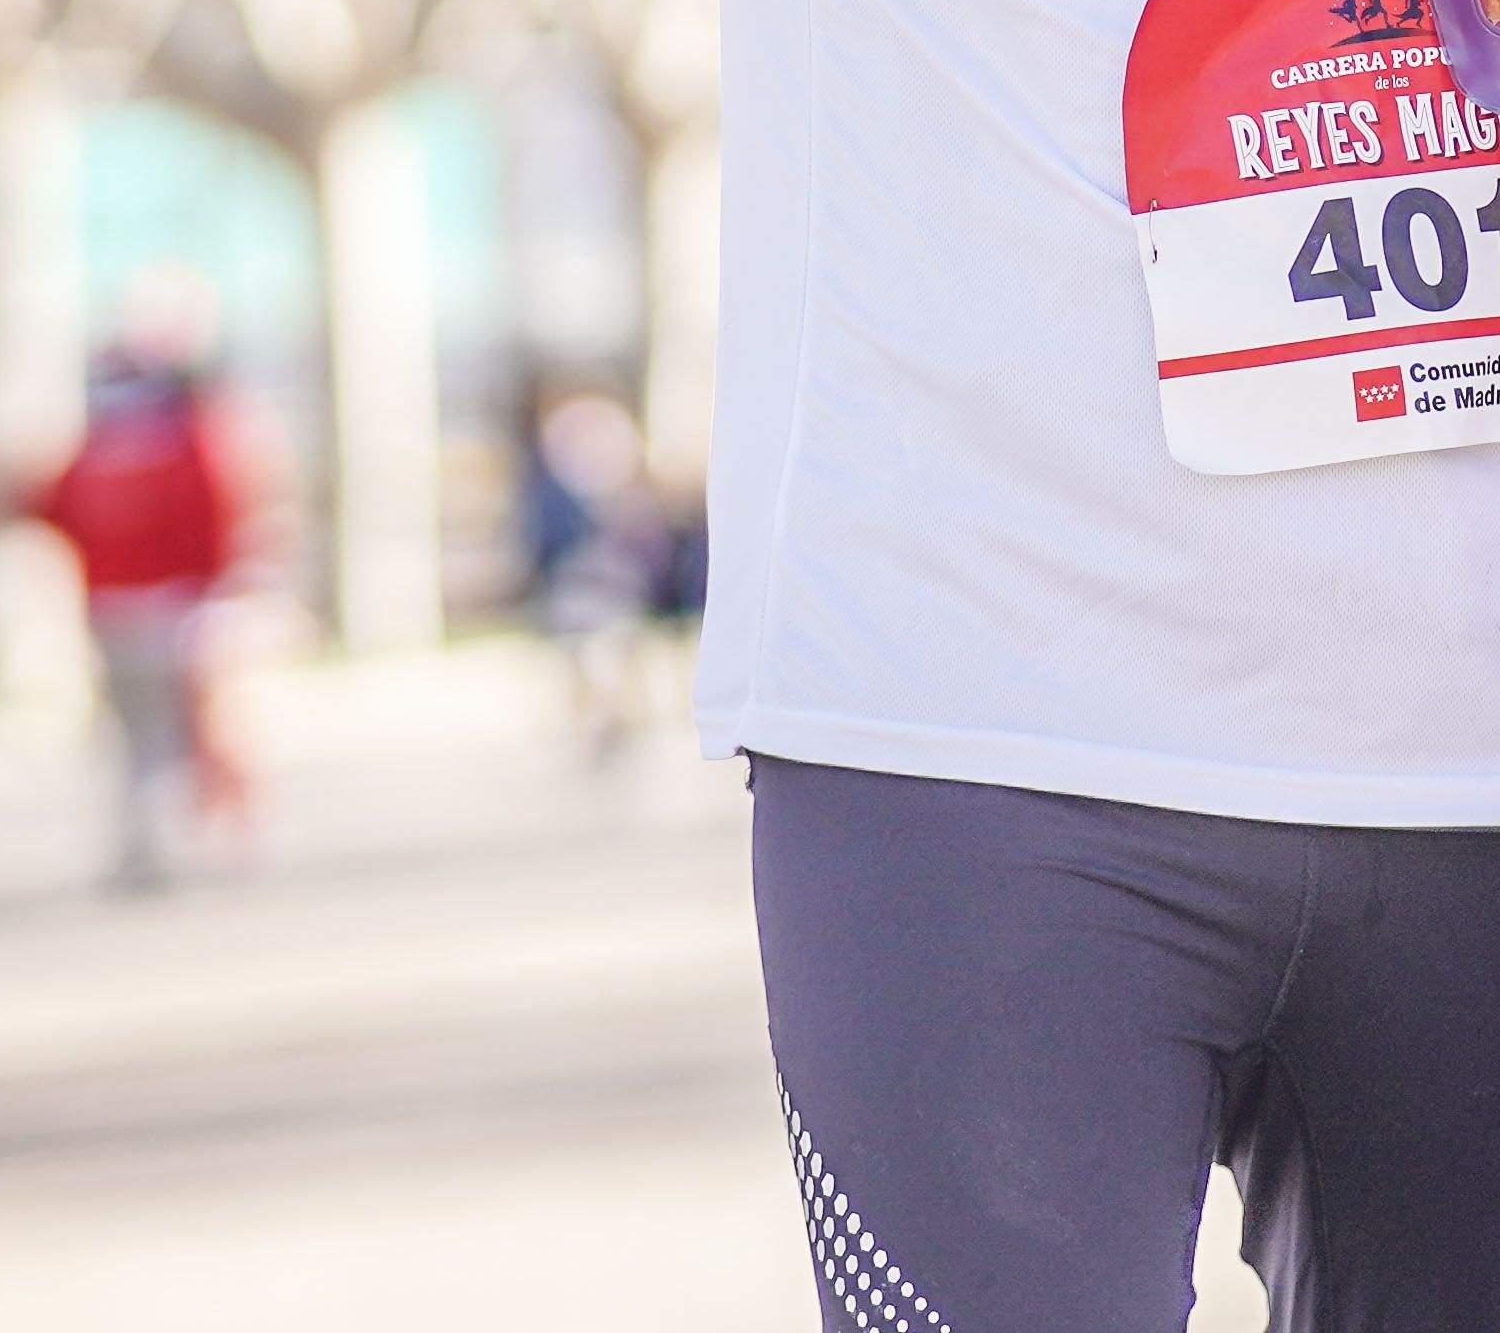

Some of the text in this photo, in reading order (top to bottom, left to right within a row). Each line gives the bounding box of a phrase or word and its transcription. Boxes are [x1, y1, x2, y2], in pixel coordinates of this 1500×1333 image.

[1270, 50, 1387, 90] CARRERA
[1374, 74, 1410, 90] de los
[1227, 100, 1381, 181] REYES
[1414, 392, 1446, 414] de
